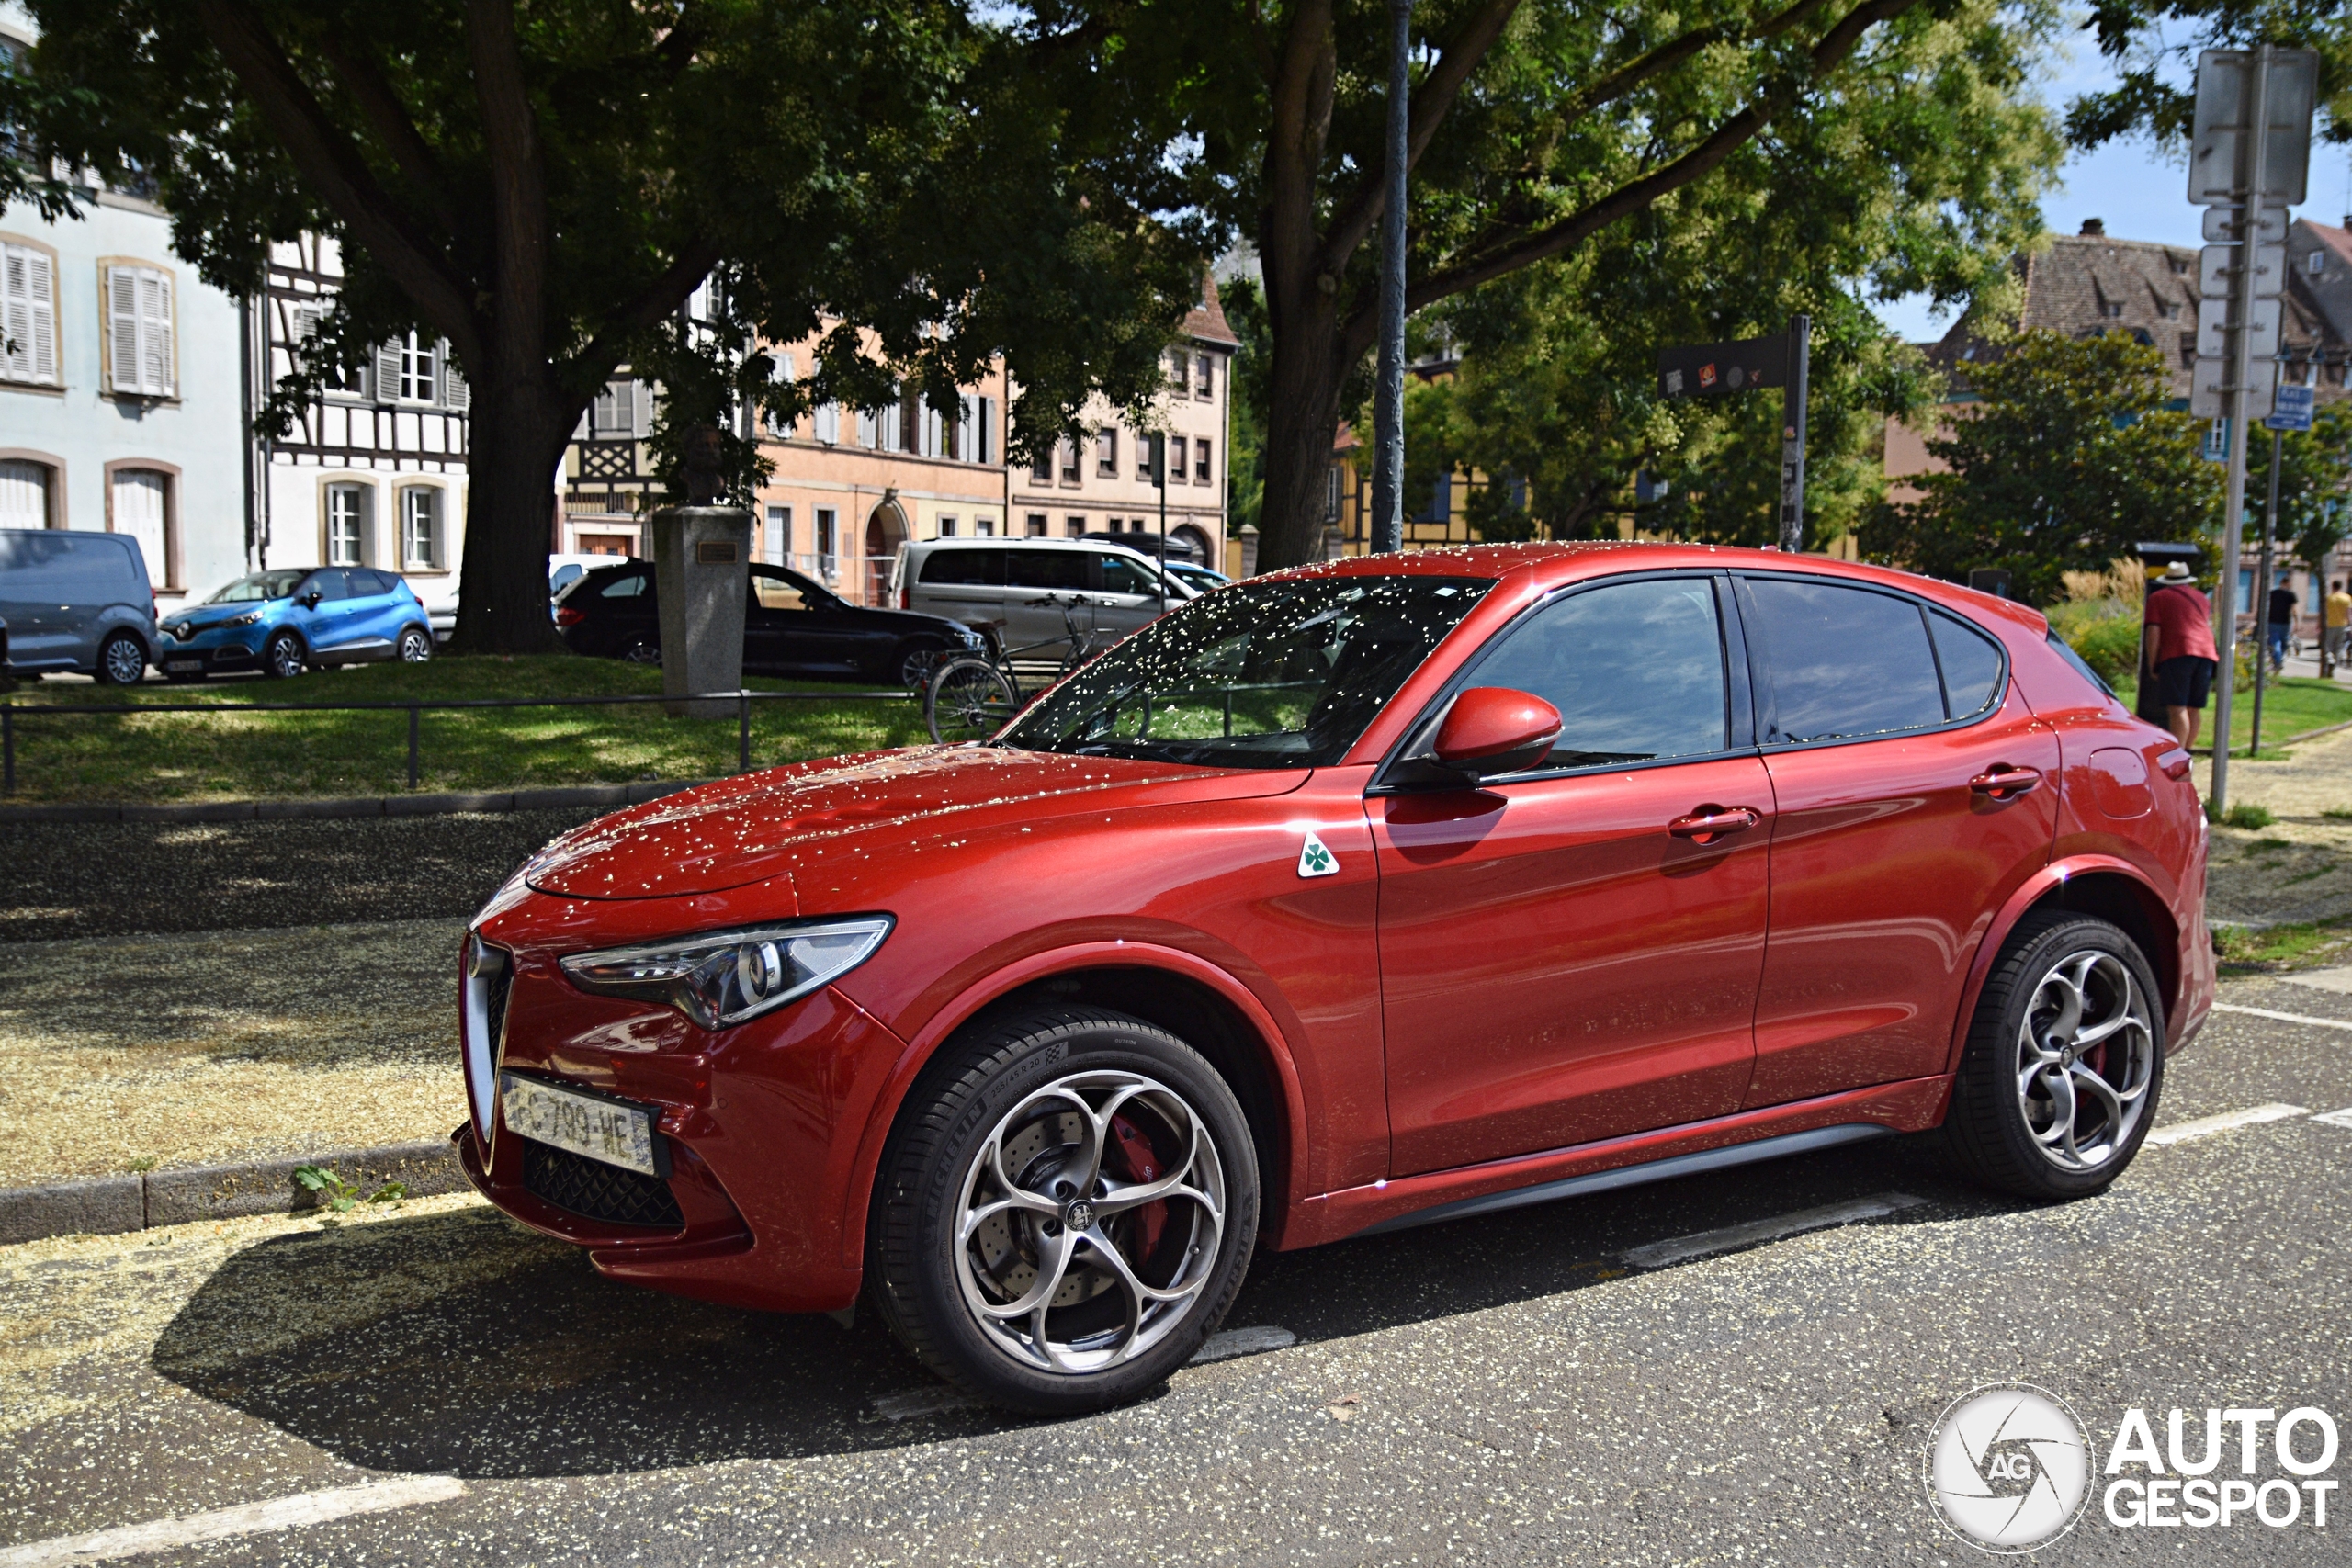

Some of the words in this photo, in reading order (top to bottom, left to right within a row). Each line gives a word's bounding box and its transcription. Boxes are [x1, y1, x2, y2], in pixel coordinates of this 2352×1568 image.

[990, 1069, 1020, 1098] 255/45
[1021, 1065, 1029, 1074] R
[1029, 1057, 1041, 1069] 20
[926, 1103, 983, 1218] MICHELIN
[1203, 1224, 1251, 1329] MICHELIN
